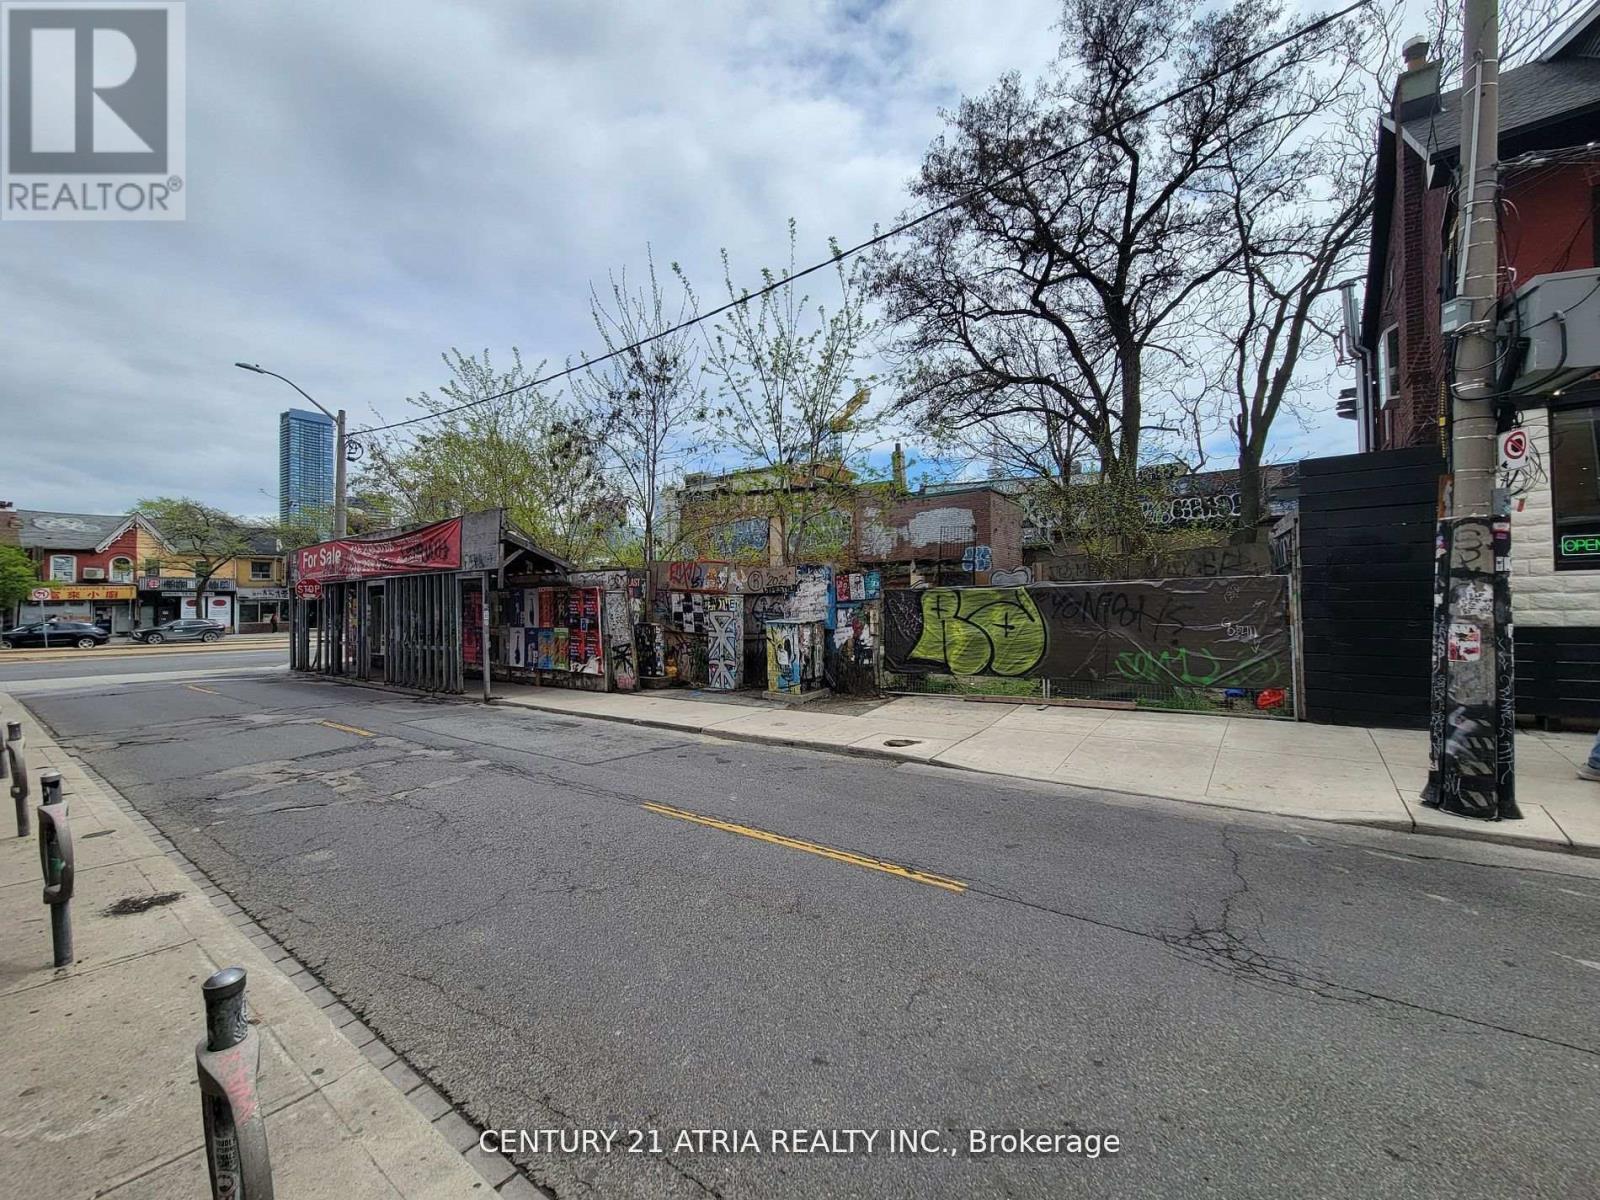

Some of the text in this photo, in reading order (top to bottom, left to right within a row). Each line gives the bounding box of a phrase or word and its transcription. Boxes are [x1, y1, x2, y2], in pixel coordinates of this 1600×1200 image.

[302, 551, 318, 569] For
[320, 546, 342, 567] Sale
[297, 584, 321, 594] STOP
